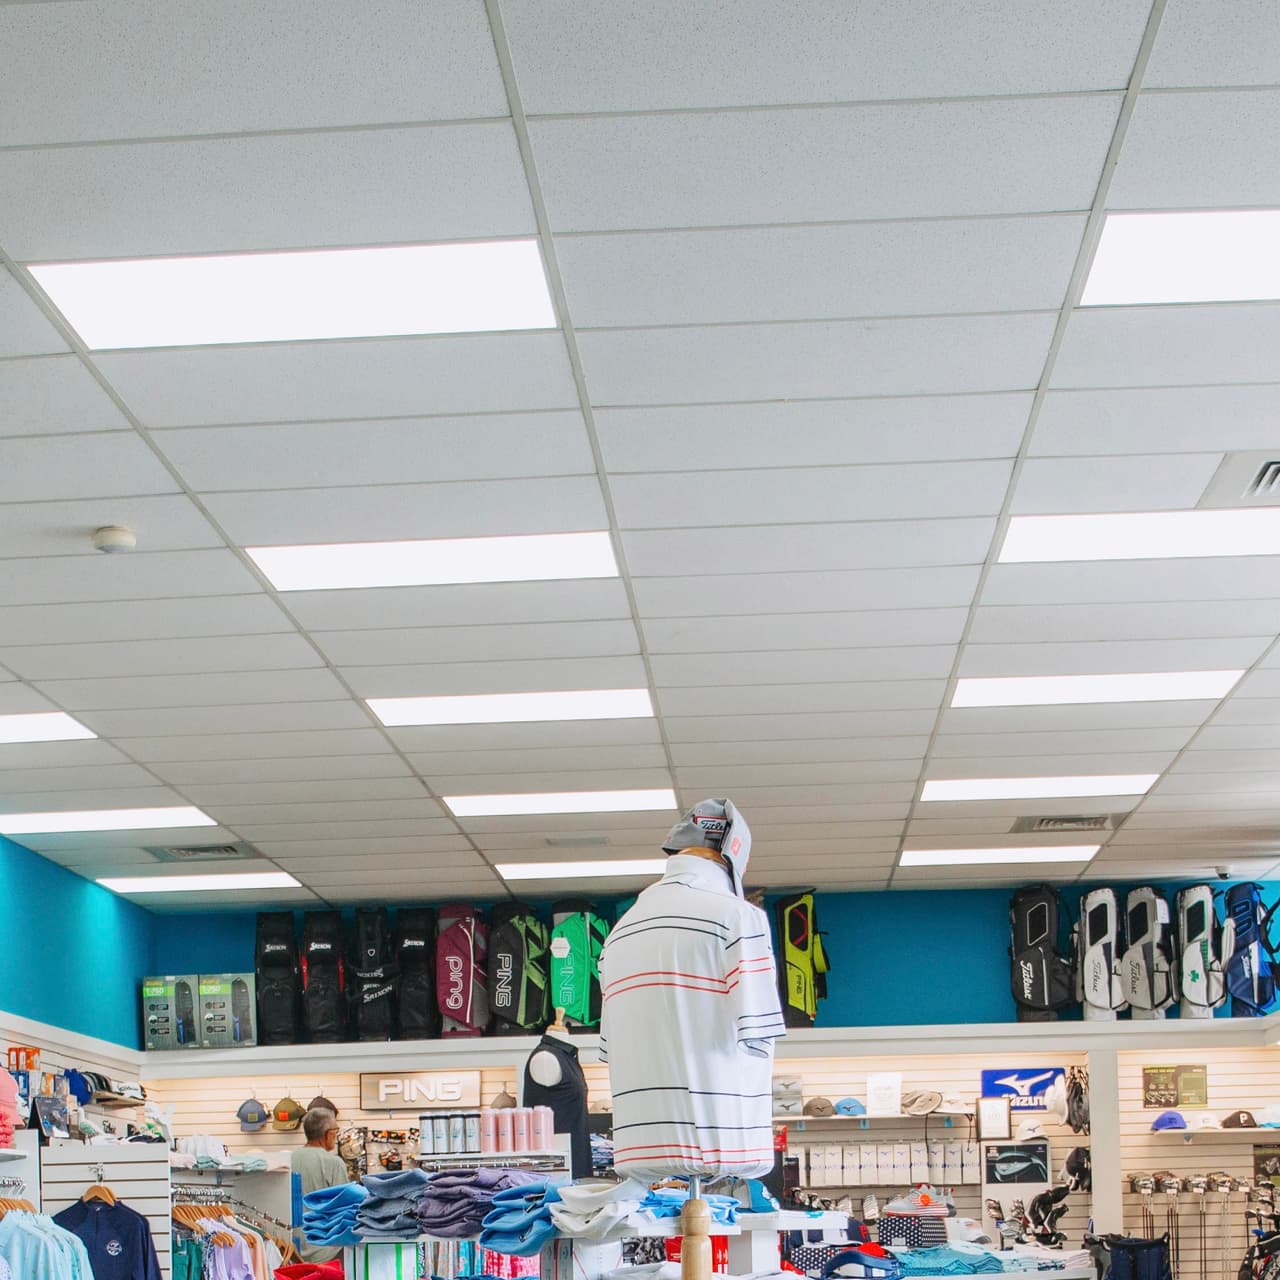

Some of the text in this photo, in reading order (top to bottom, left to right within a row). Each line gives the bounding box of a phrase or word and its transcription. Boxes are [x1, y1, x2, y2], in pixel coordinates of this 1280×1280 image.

[701, 819, 725, 831] Title
[495, 953, 512, 1007] PING
[560, 952, 575, 1005] PING
[378, 1079, 463, 1102] PING
